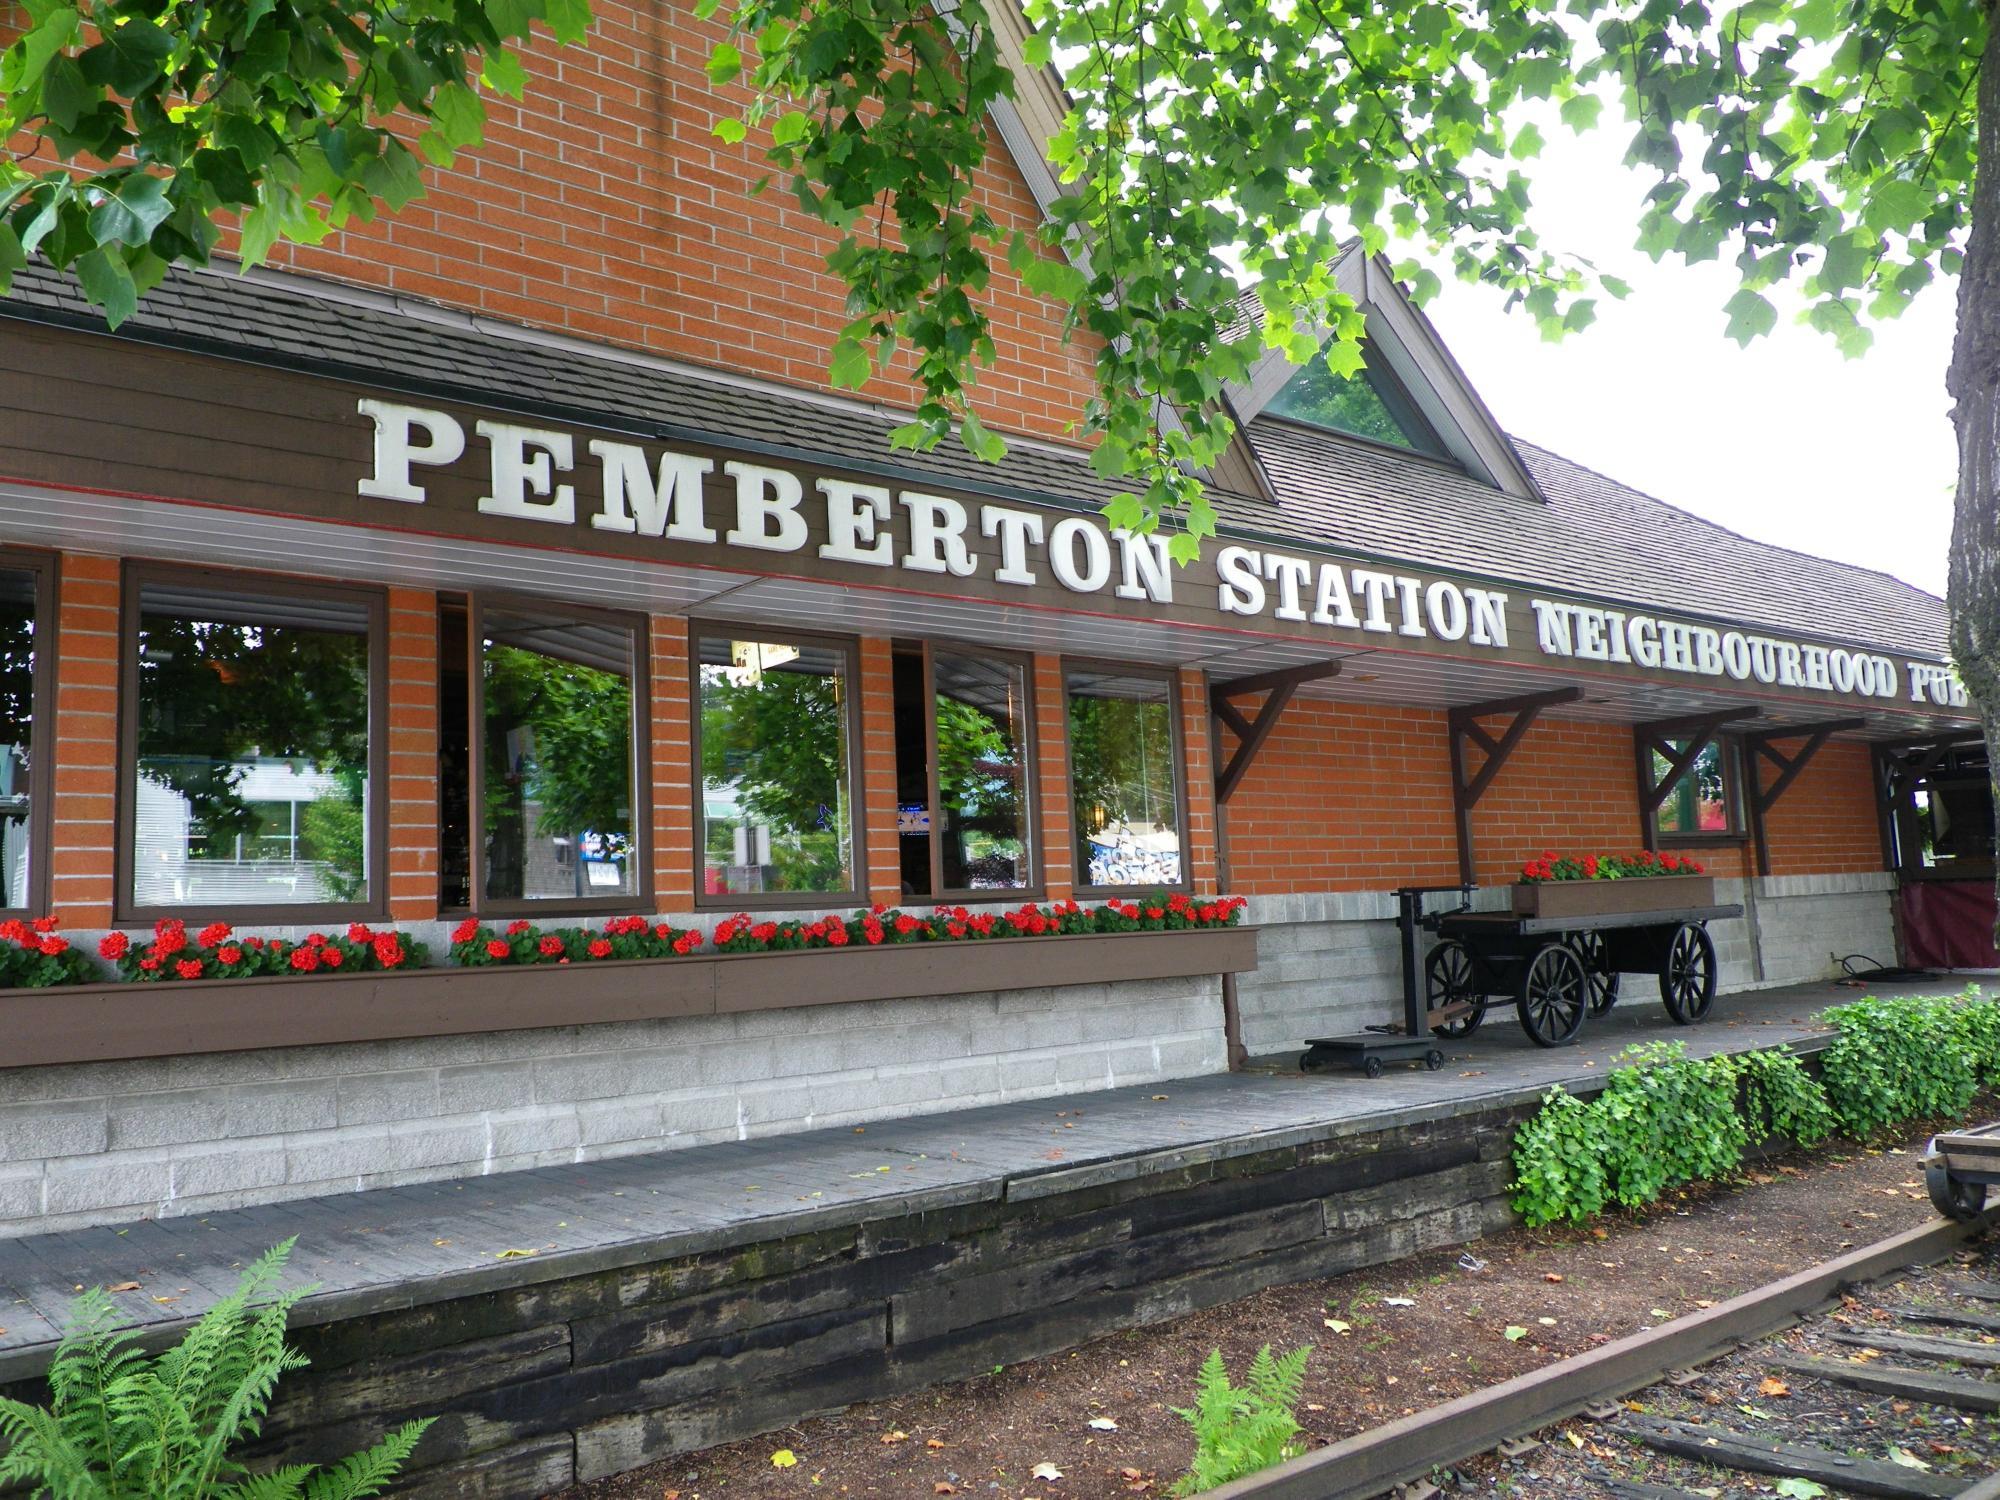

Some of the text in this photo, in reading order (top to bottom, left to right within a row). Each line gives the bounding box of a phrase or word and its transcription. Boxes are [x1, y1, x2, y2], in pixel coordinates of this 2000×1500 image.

[357, 398, 1173, 603] PEMBERTON
[1216, 546, 1509, 647] STATION
[1531, 599, 1899, 698] NEIGHBOURHOOD
